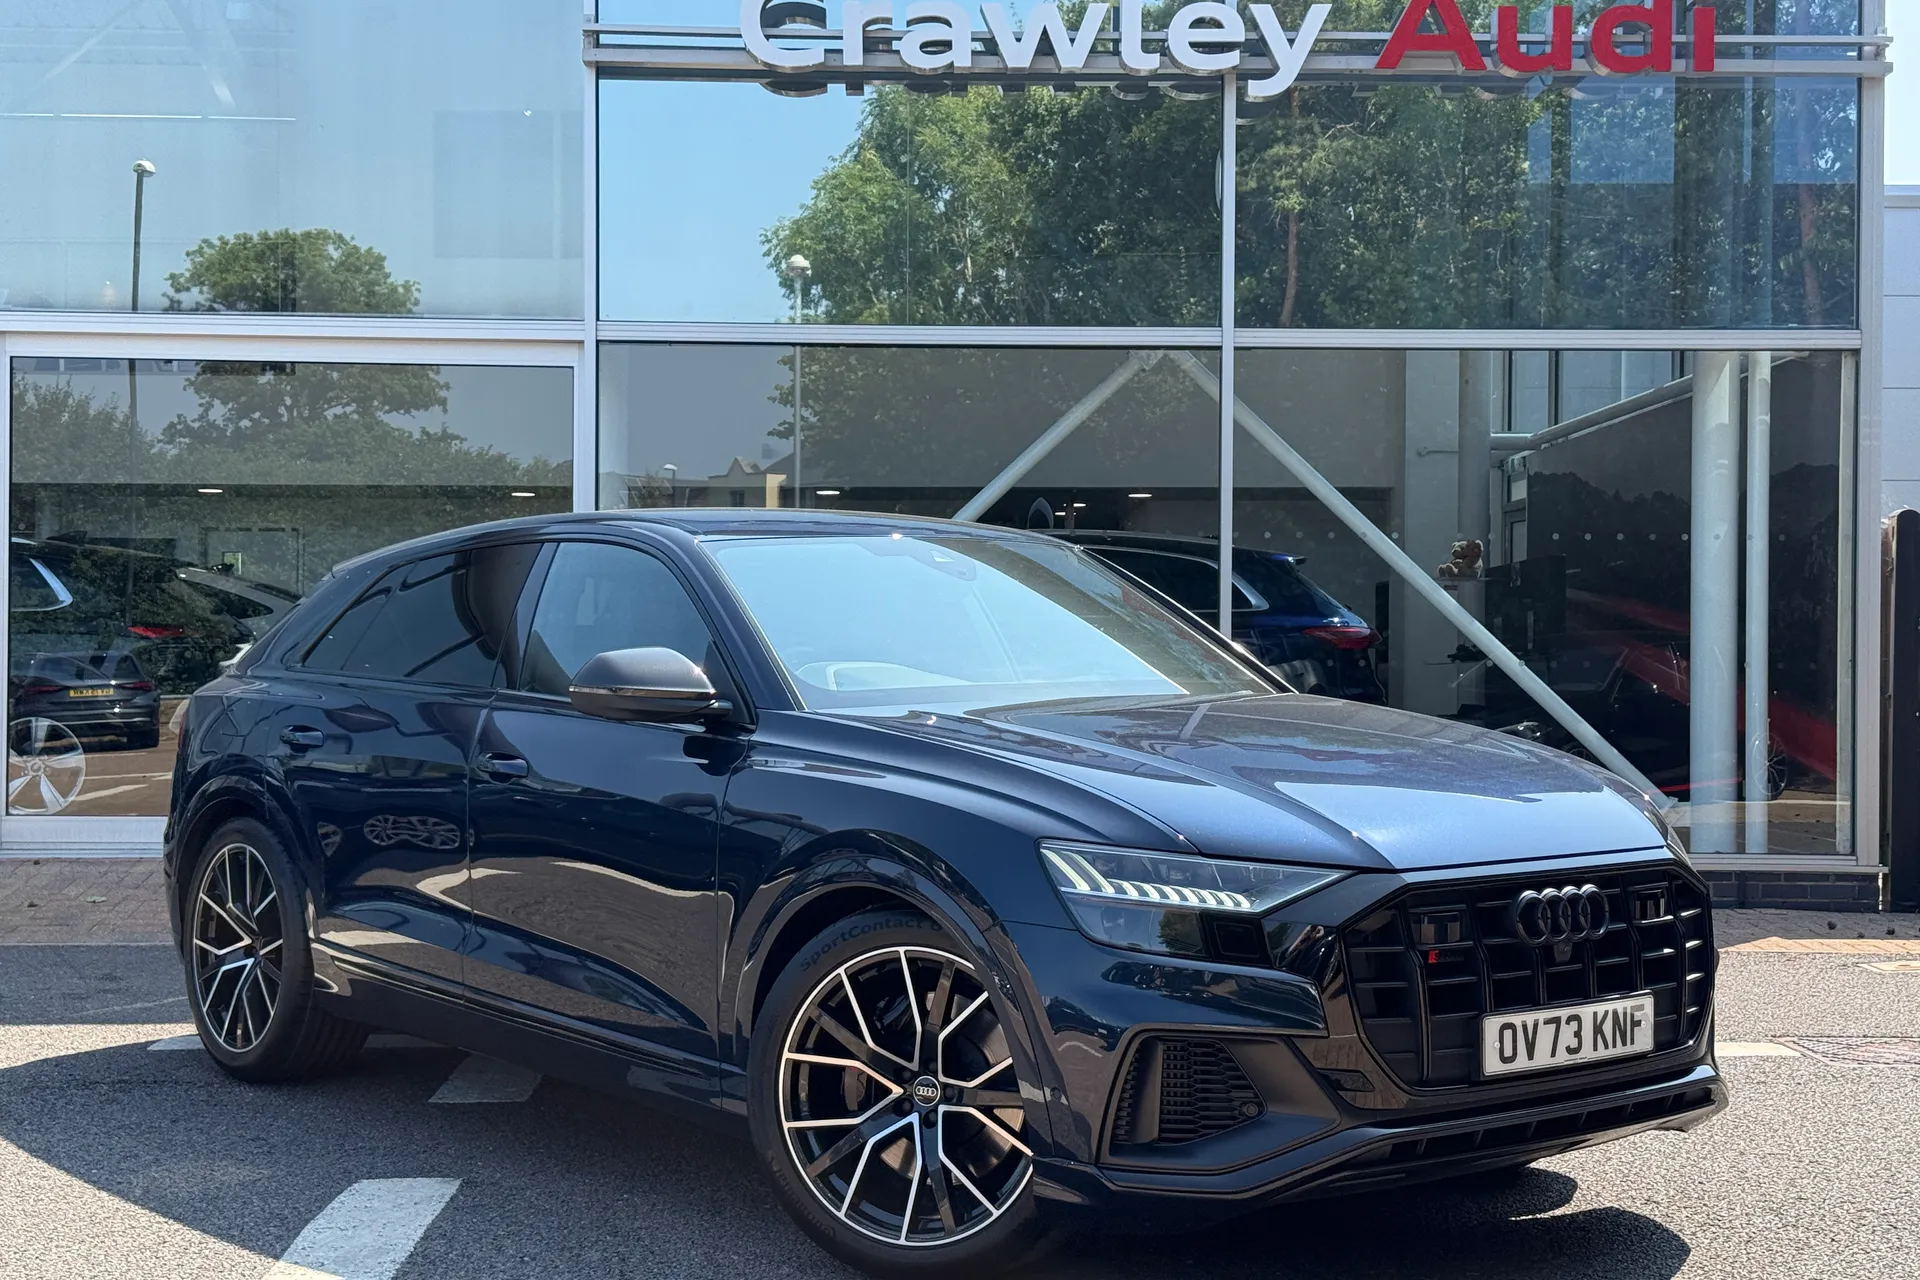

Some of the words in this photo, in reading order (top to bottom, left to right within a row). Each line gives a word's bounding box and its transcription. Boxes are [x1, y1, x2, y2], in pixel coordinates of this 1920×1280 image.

[741, 0, 1331, 96] Crawley
[1375, 0, 1716, 72] Audi
[801, 917, 924, 972] SportContact
[1498, 1014, 1583, 1064] OV73
[1592, 1003, 1645, 1052] KNF
